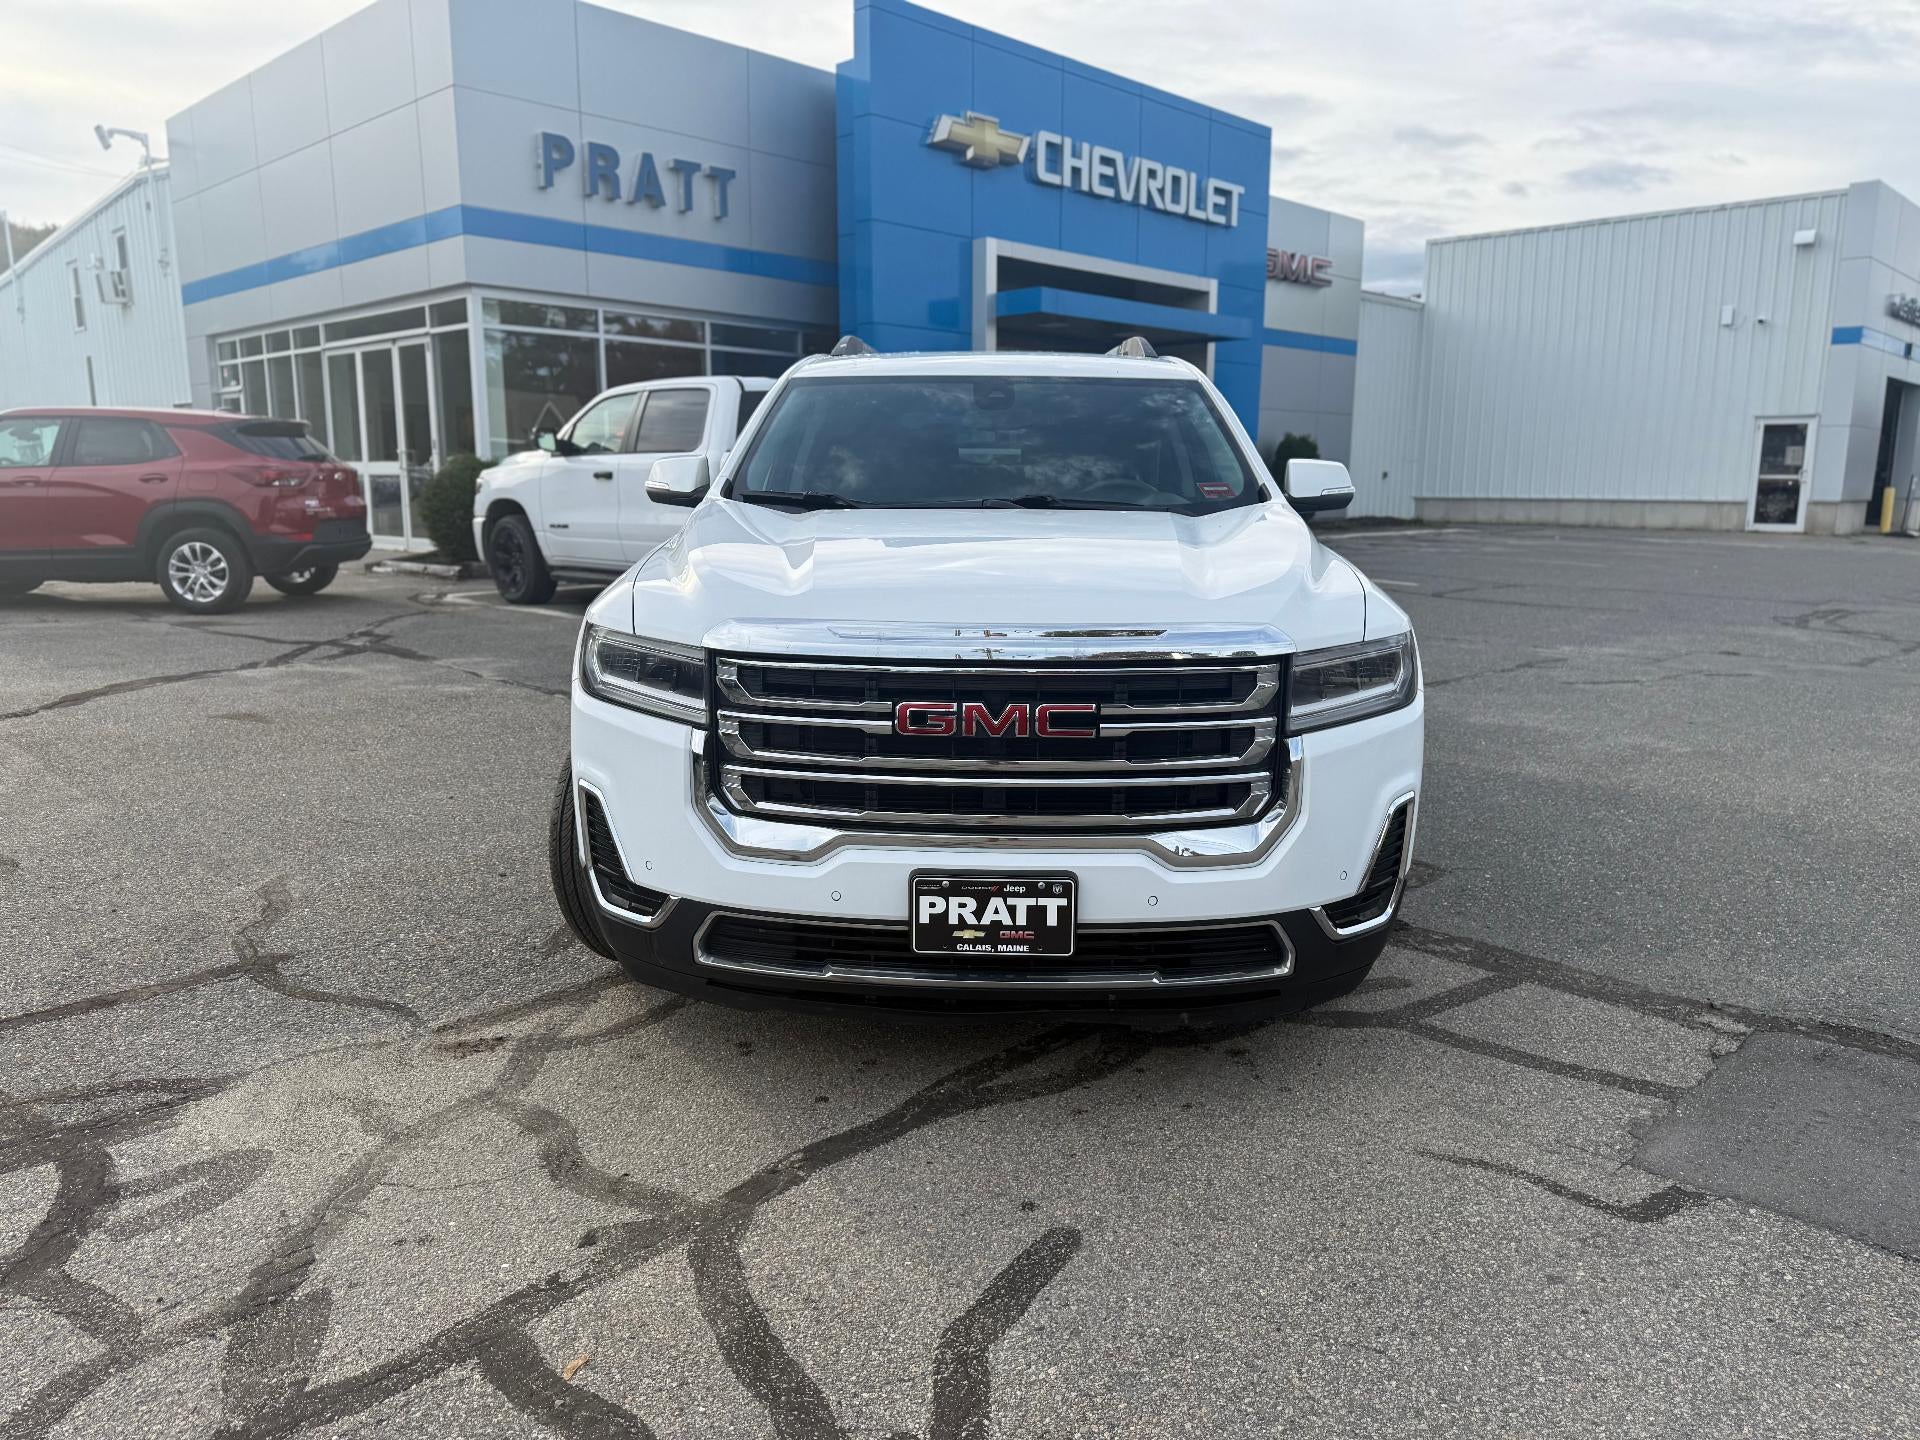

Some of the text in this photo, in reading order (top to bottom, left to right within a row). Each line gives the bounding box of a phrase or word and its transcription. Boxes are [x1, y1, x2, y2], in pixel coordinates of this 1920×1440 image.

[537, 131, 736, 219] PRATT
[1035, 129, 1245, 227] CHEVROLET
[895, 701, 1097, 738] GMC
[1003, 883, 1026, 894] Jeep
[918, 895, 1068, 927] PRATT
[956, 943, 1030, 952] CALAIS, MAINE
[1000, 930, 1035, 939] GMC
